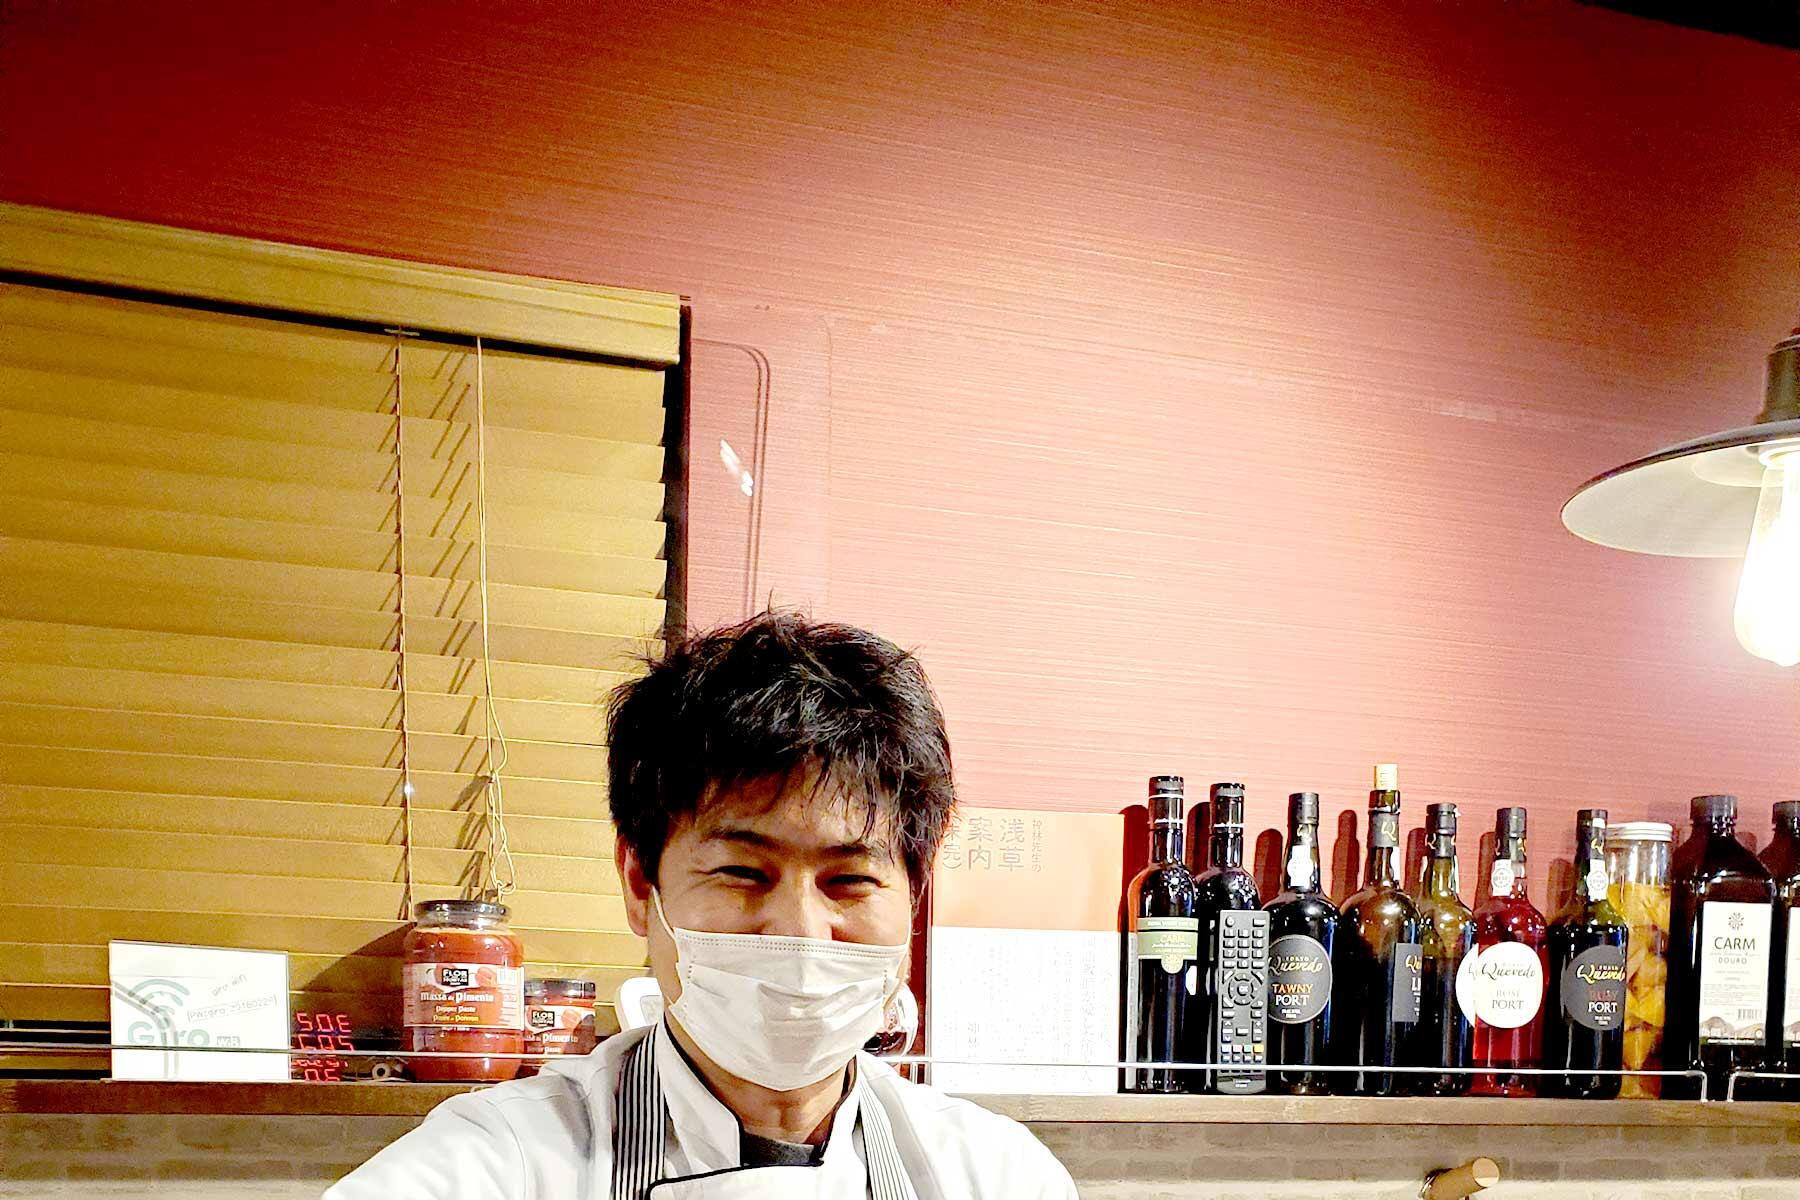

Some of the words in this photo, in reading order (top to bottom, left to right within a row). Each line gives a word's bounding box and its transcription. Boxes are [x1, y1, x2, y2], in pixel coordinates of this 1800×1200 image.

[967, 816, 994, 872] 案内
[998, 817, 1025, 872] 浅草
[1714, 936, 1756, 950] CARM
[1268, 956, 1323, 975] Quevedo
[1718, 957, 1748, 965] DOURO
[443, 968, 467, 977] FLOR
[1481, 962, 1535, 980] Quevedo
[1272, 983, 1313, 994] TAWNY
[1275, 995, 1310, 1006] PORT
[1491, 999, 1524, 1010] PORT
[1588, 1002, 1618, 1013] PORT
[532, 1011, 553, 1019] FLOR
[128, 1021, 210, 1047] Giro
